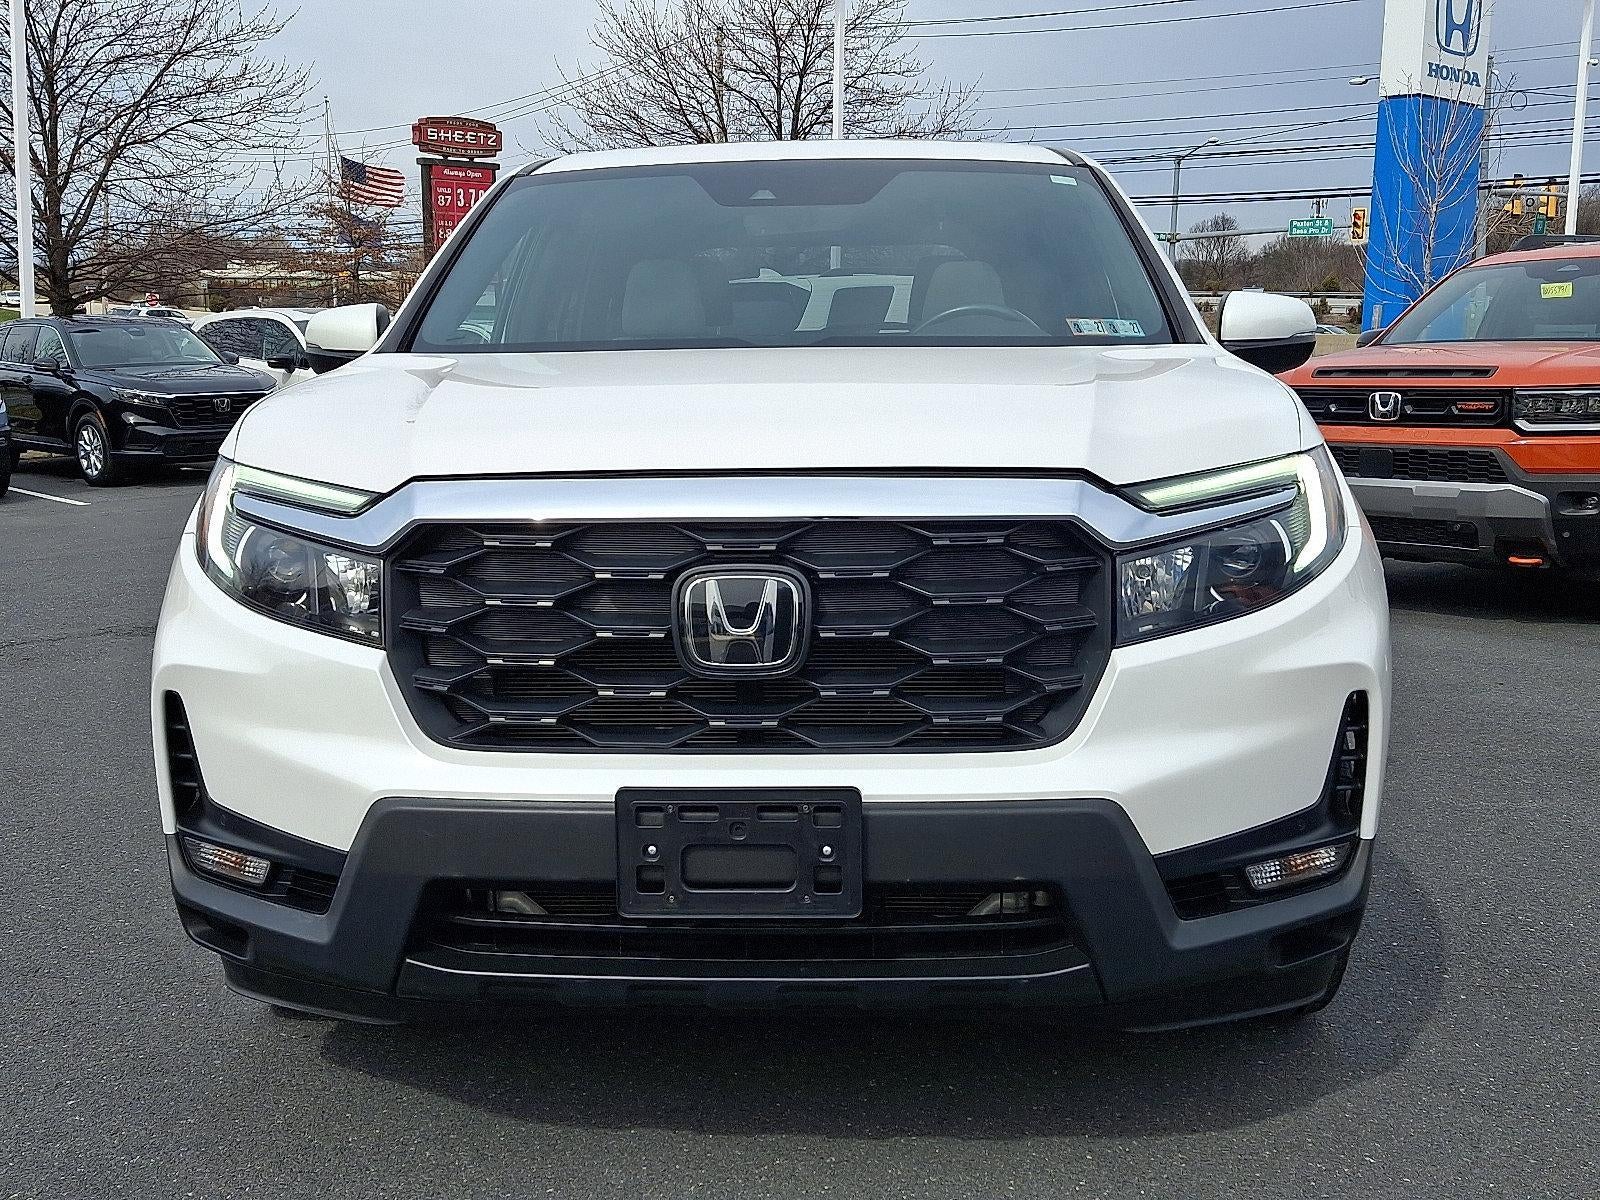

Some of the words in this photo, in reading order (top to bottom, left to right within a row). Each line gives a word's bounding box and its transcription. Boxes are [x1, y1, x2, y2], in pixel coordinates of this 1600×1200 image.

[1427, 62, 1481, 87] HONDA
[427, 128, 496, 145] SHEETZ
[444, 168, 465, 178] Always
[466, 170, 482, 178] Open
[437, 195, 451, 206] 87
[1094, 321, 1105, 333] 27
[1129, 322, 1140, 334] 27
